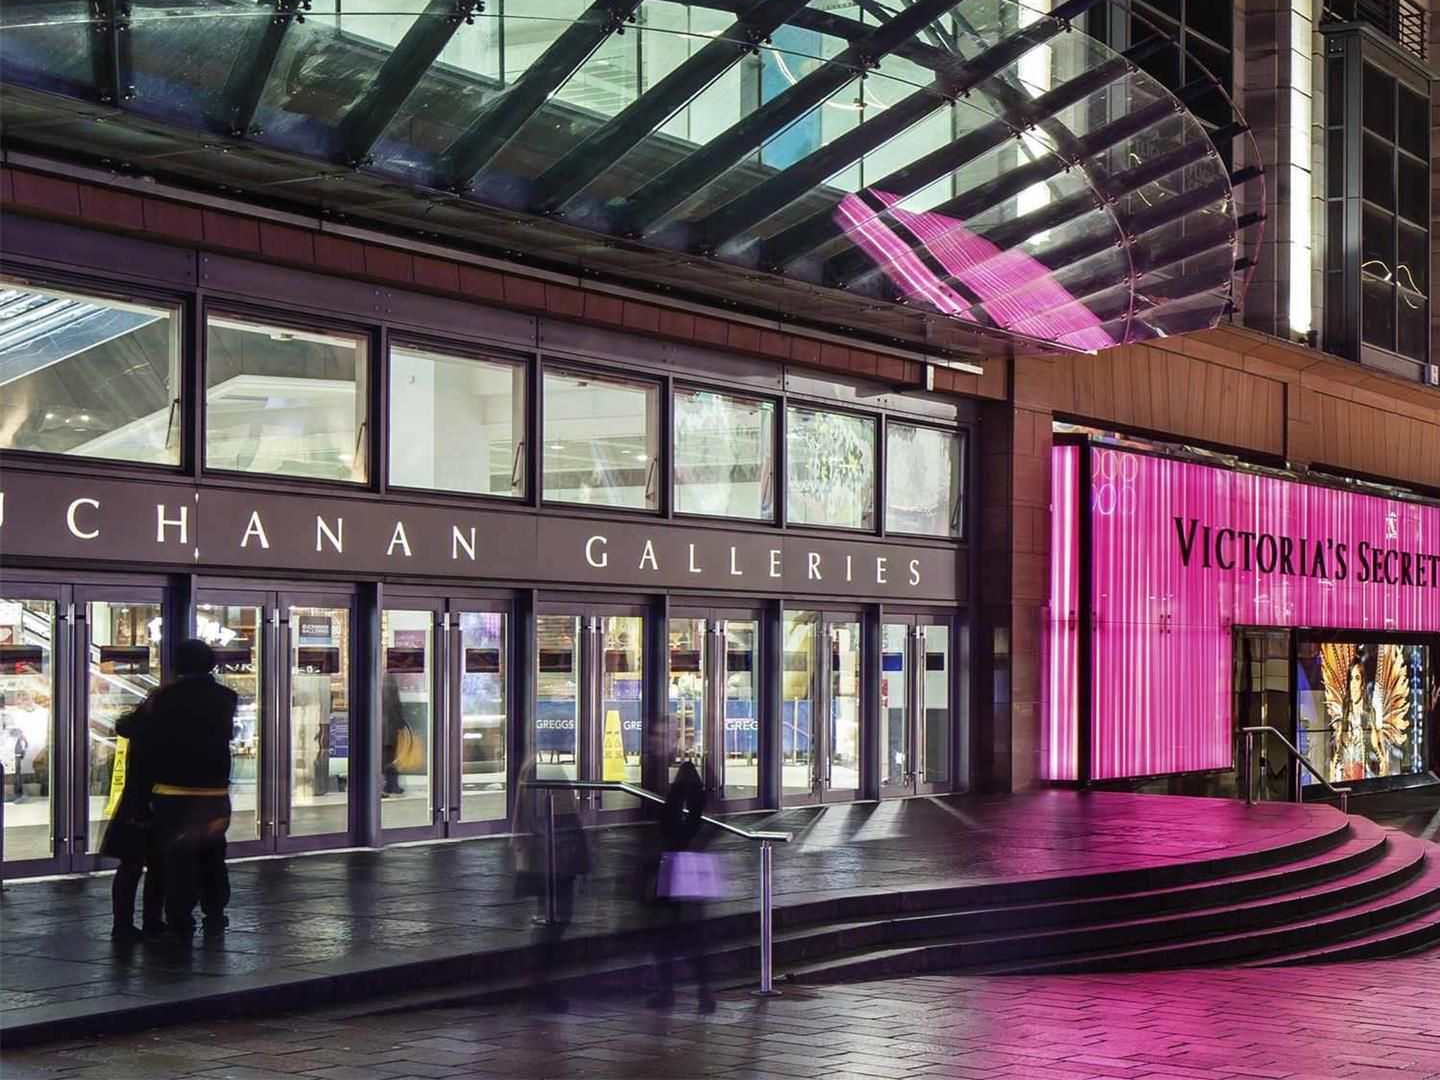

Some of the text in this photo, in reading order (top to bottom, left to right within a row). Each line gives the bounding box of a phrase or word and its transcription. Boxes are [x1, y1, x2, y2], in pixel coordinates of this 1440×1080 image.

[0, 493, 920, 586] CHANAN GALLERIES
[1175, 517, 1347, 581] VICTORIA'S
[1358, 541, 1440, 588] SECRET
[536, 720, 574, 730] GREGGS
[623, 720, 642, 730] GRE
[726, 721, 758, 731] GREG
